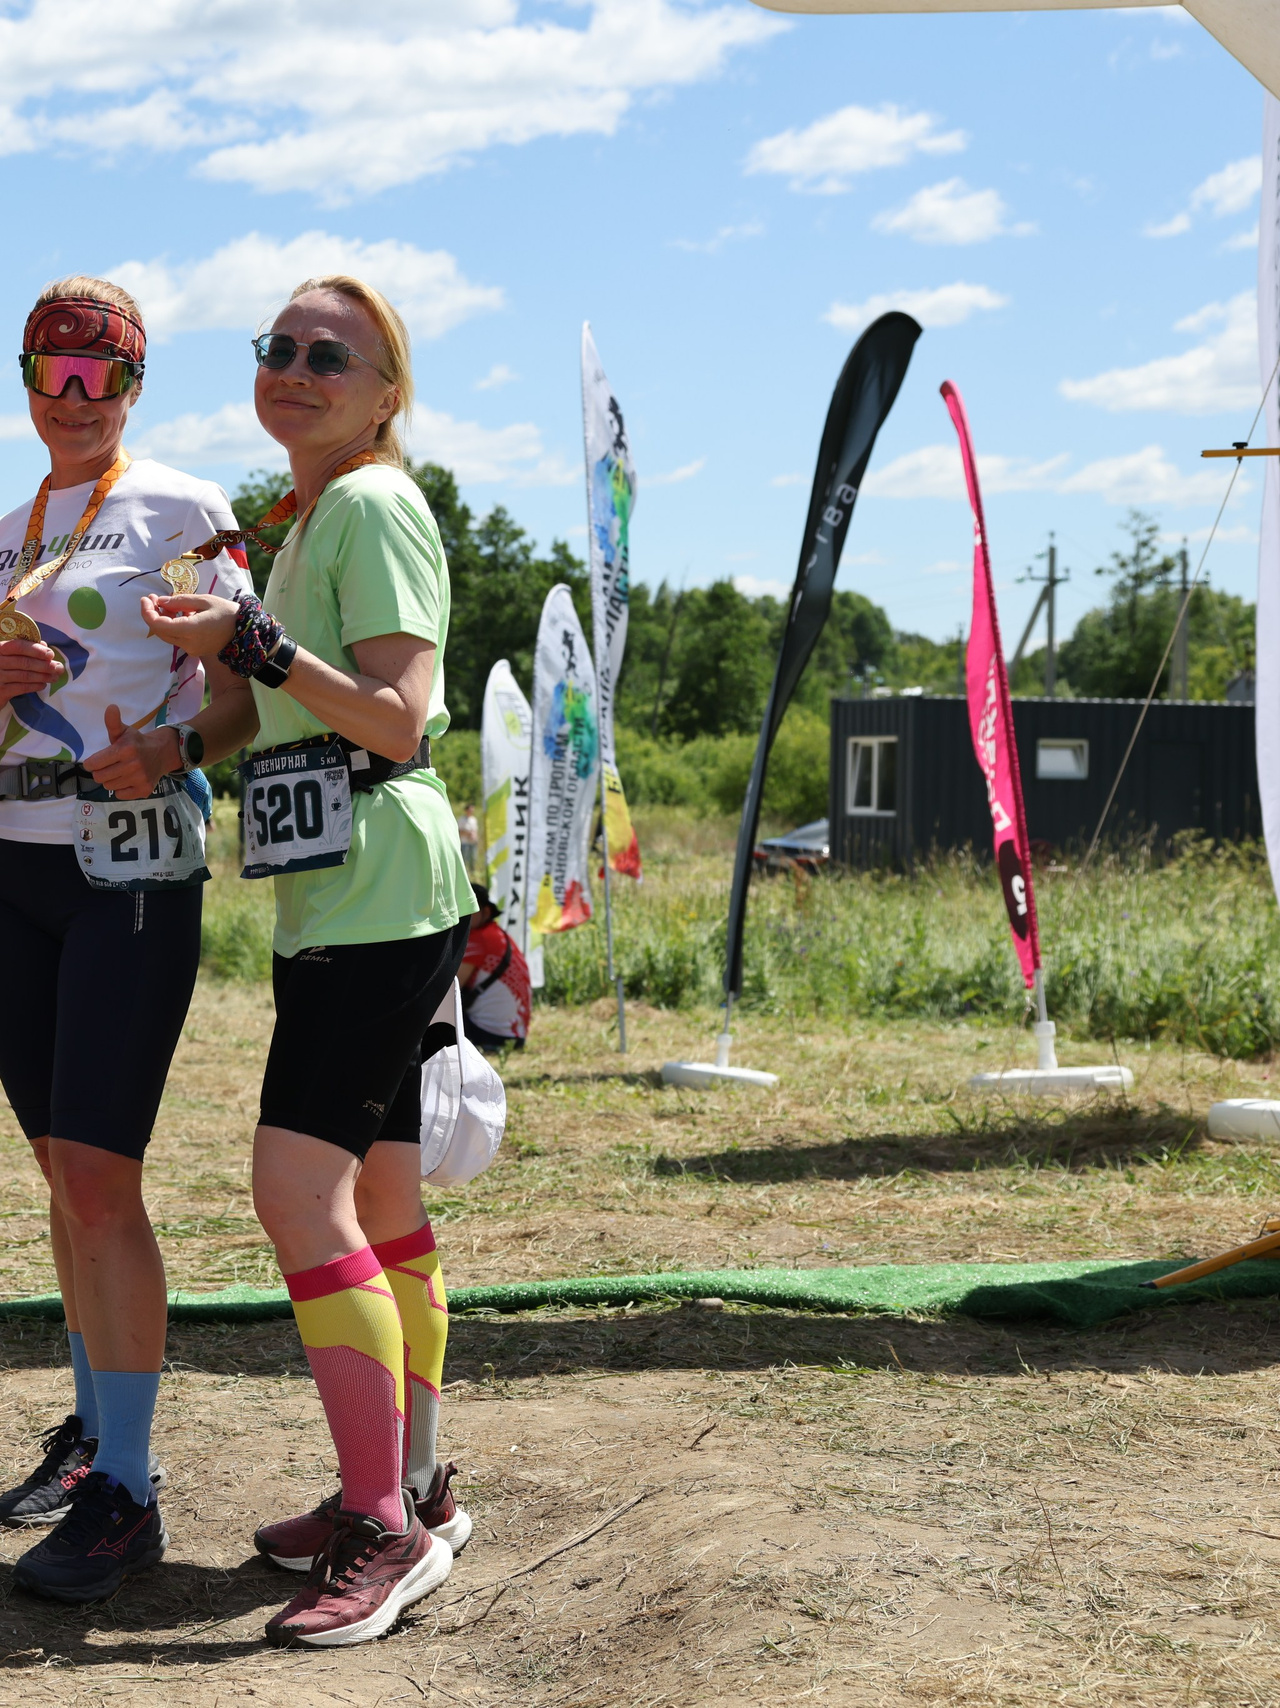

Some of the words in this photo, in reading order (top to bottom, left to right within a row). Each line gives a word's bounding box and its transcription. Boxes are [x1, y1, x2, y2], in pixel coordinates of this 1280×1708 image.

[20, 538, 38, 569] СЕЗОНА
[320, 757, 325, 765] 5
[326, 756, 337, 764] КМ
[548, 733, 569, 800] ТРОПАМ
[108, 805, 183, 862] 219
[252, 779, 324, 847] 520
[548, 804, 558, 827] ПО
[556, 797, 576, 906] ИВАНОВСКОЙ
[568, 717, 586, 794] ОБЛАСТИ
[507, 775, 529, 926] ТУРНИК
[543, 831, 556, 888] БЕГОМ
[300, 955, 333, 963] DEMIX
